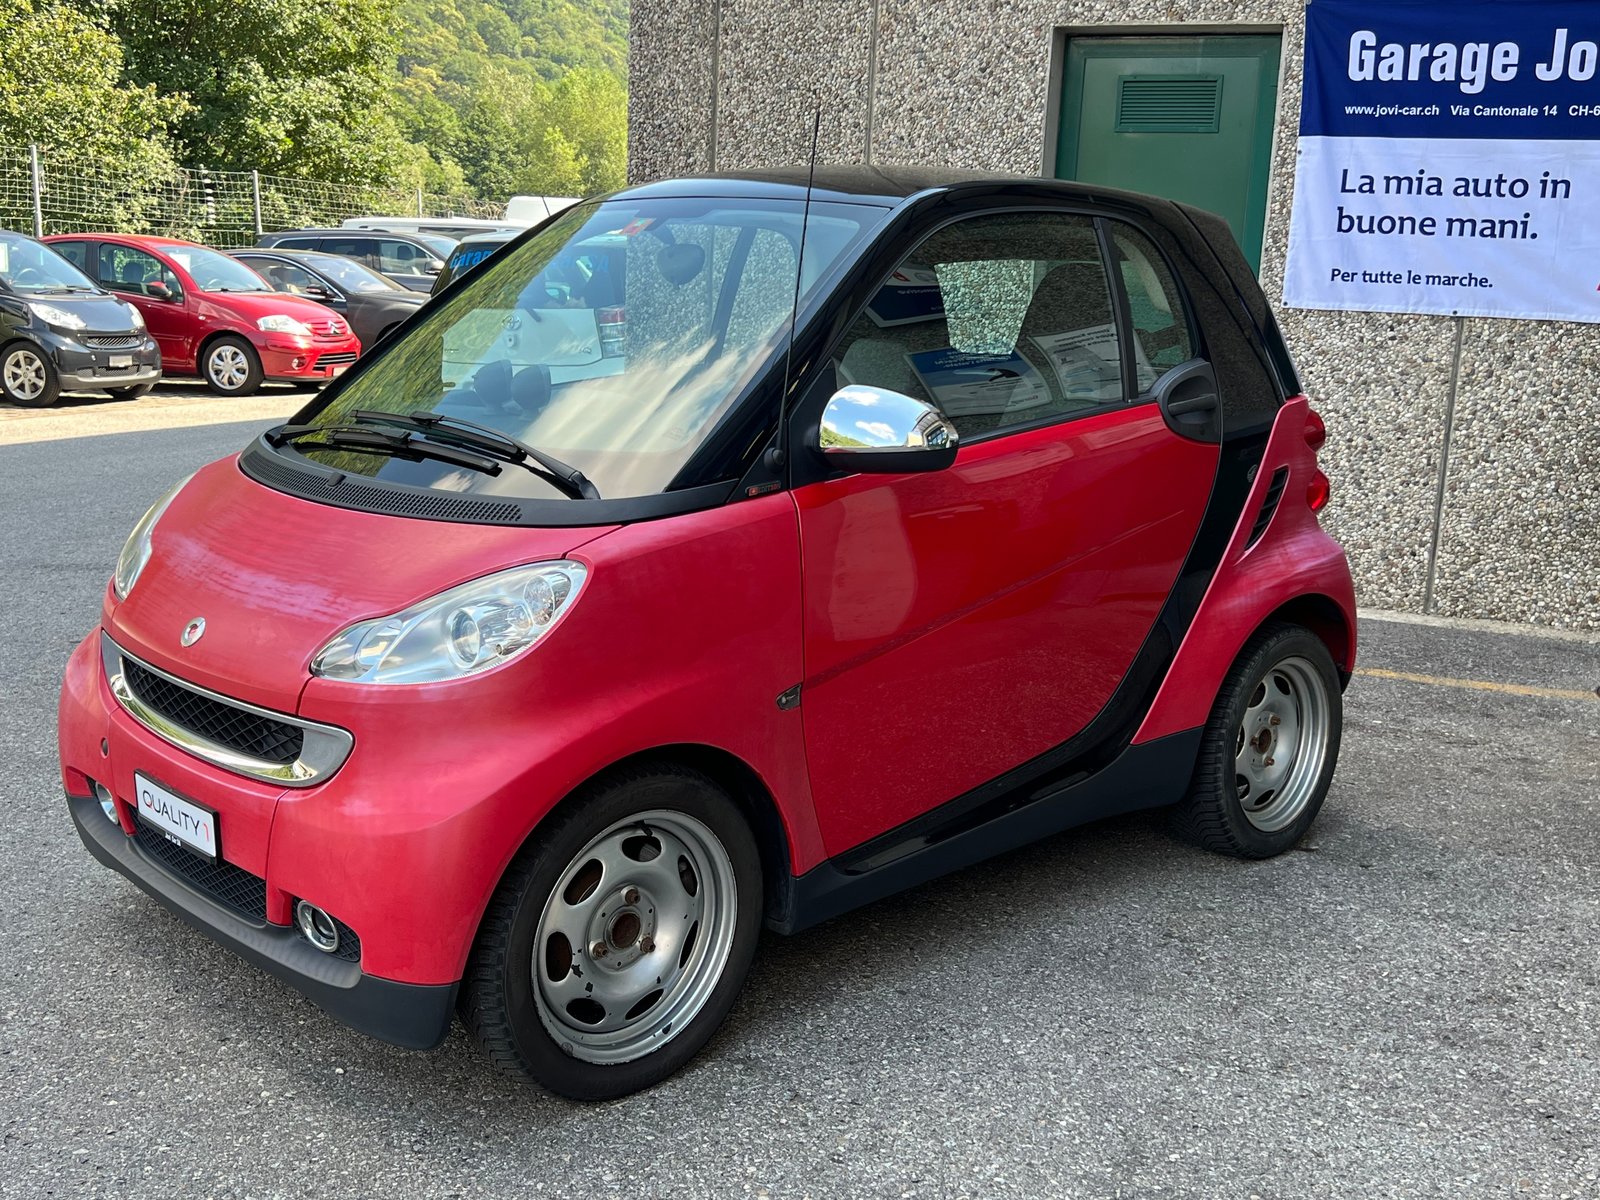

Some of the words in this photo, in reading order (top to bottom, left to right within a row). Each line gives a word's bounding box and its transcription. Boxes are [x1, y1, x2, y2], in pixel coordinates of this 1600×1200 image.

[1347, 29, 1520, 95] Garage
[1535, 27, 1599, 82] Jo
[1344, 104, 1440, 118] www.jovi-car.ch
[1450, 104, 1470, 117] Via
[1473, 104, 1539, 117] Cantonale
[1542, 104, 1558, 117] 14
[1340, 168, 1376, 195] La
[1383, 168, 1443, 197] mia
[1452, 173, 1530, 199] auto
[1539, 171, 1572, 199] in
[1336, 206, 1437, 237] buone
[1445, 212, 1538, 240] mani.
[1330, 268, 1358, 283] Per
[1362, 269, 1403, 285] tutte
[1407, 269, 1422, 285] le
[1425, 272, 1494, 288] marche.
